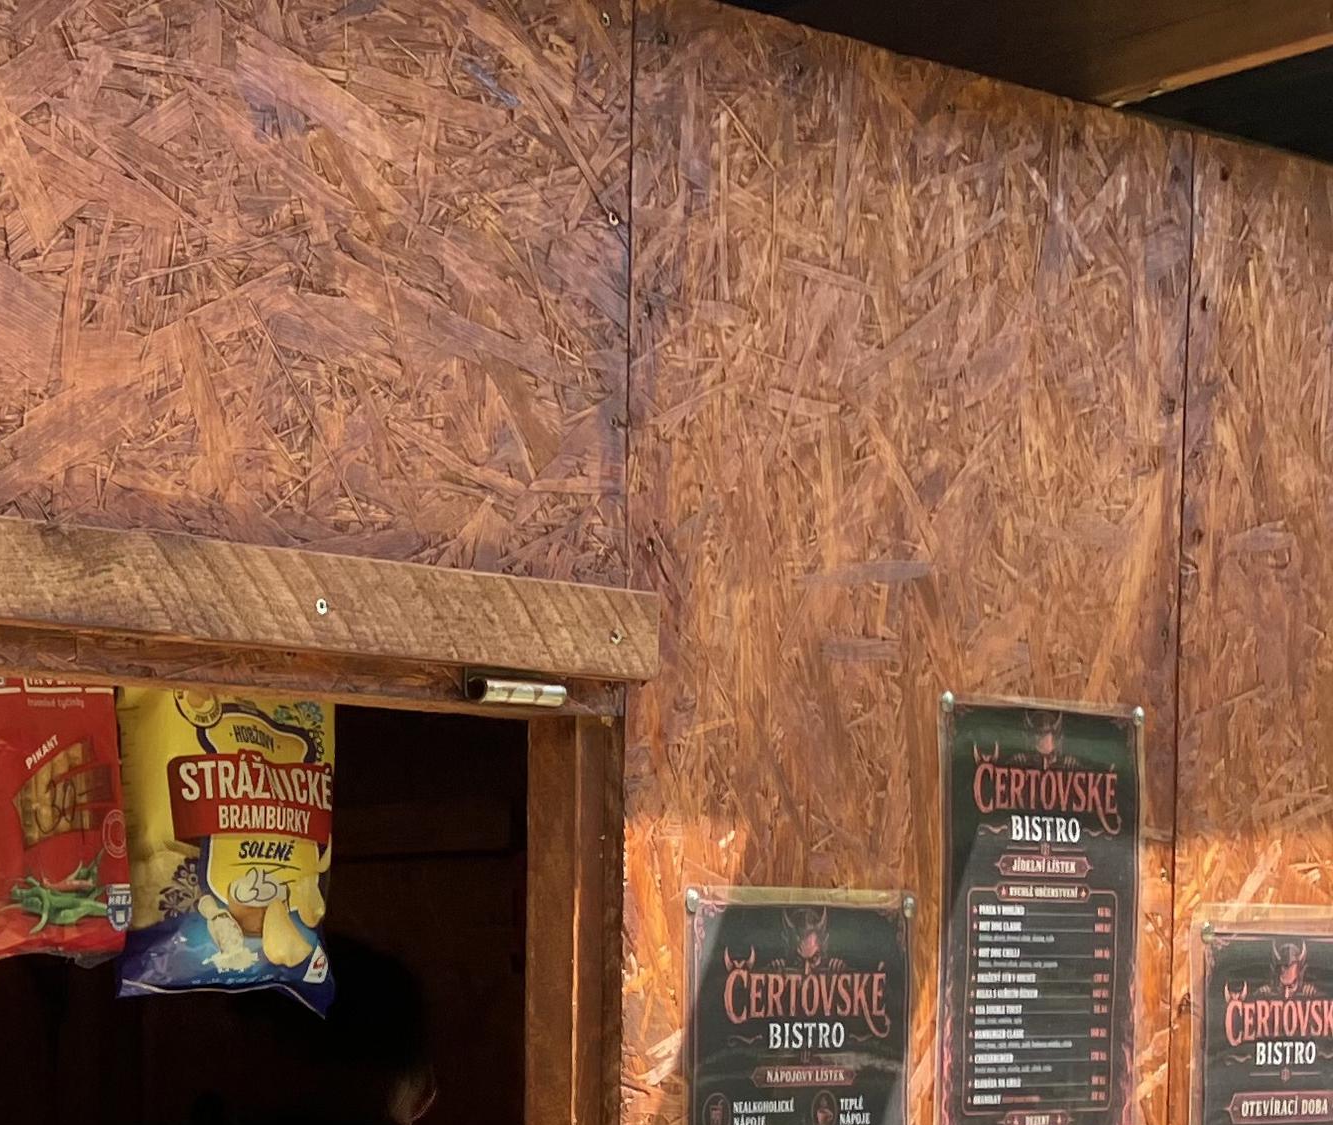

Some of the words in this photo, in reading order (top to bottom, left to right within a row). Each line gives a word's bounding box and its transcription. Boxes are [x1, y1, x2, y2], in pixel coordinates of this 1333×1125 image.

[24, 734, 79, 770] PIKANT
[179, 753, 333, 811] STRÁŽNICKÉ
[974, 754, 1121, 834] ČERTOVSKÉ
[1011, 815, 1080, 843] BISTRO
[238, 840, 294, 861] SOLENÉ
[724, 958, 890, 1036] ČERTOVSKÉ
[1225, 990, 1333, 1047] ČERTOVSK
[768, 1022, 845, 1049] BISTRO
[1255, 1041, 1316, 1065] BISTRO
[815, 1068, 845, 1082] LÍSTEK
[733, 1097, 794, 1113] NEALKOHOLICKÉ
[839, 1095, 864, 1111] TEPLÉ
[1241, 1096, 1298, 1117] OTEVÍRACÍ
[1301, 1097, 1329, 1115] DOBA
[839, 1111, 871, 1125] NÁPOJE
